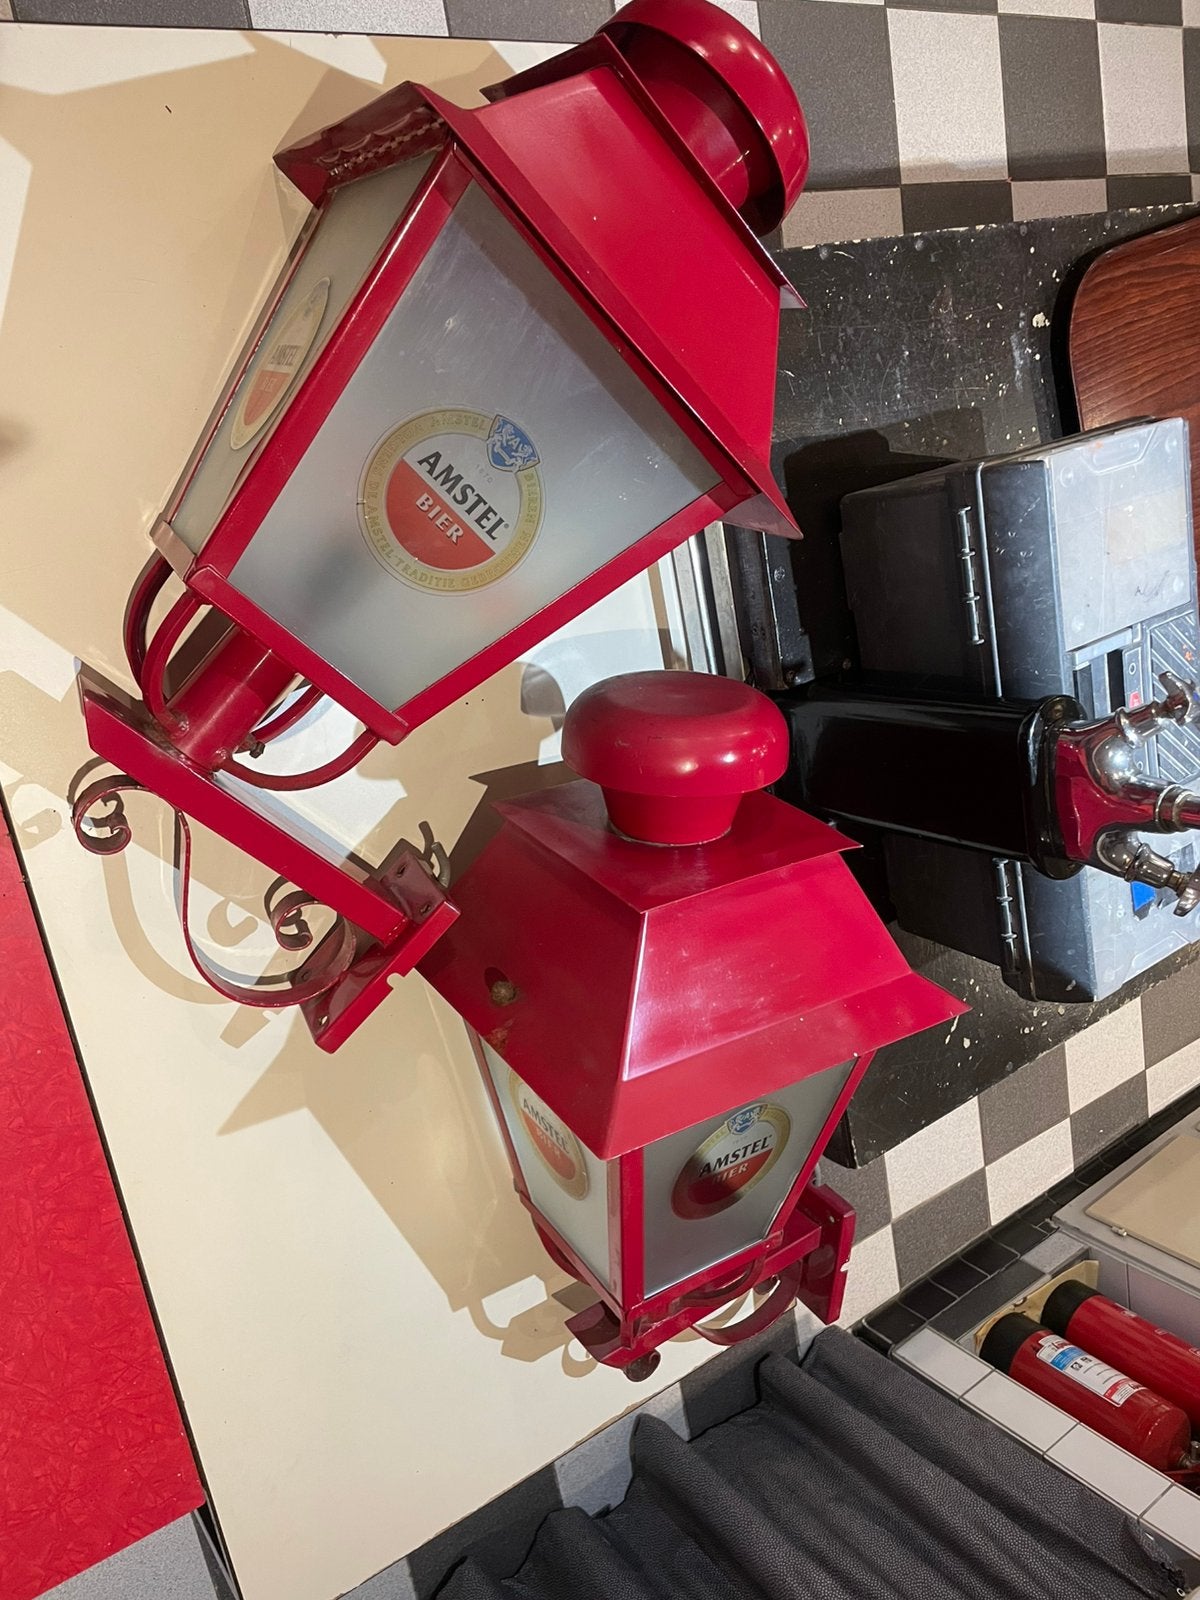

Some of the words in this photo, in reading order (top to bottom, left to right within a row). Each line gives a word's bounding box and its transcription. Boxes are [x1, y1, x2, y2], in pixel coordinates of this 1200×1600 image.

[415, 492, 464, 546] BIER
[417, 451, 497, 540] AMSTEL
[366, 506, 393, 559] AMSTEL
[522, 1098, 570, 1154] AMSTEL
[699, 1136, 768, 1177] AMSTEL
